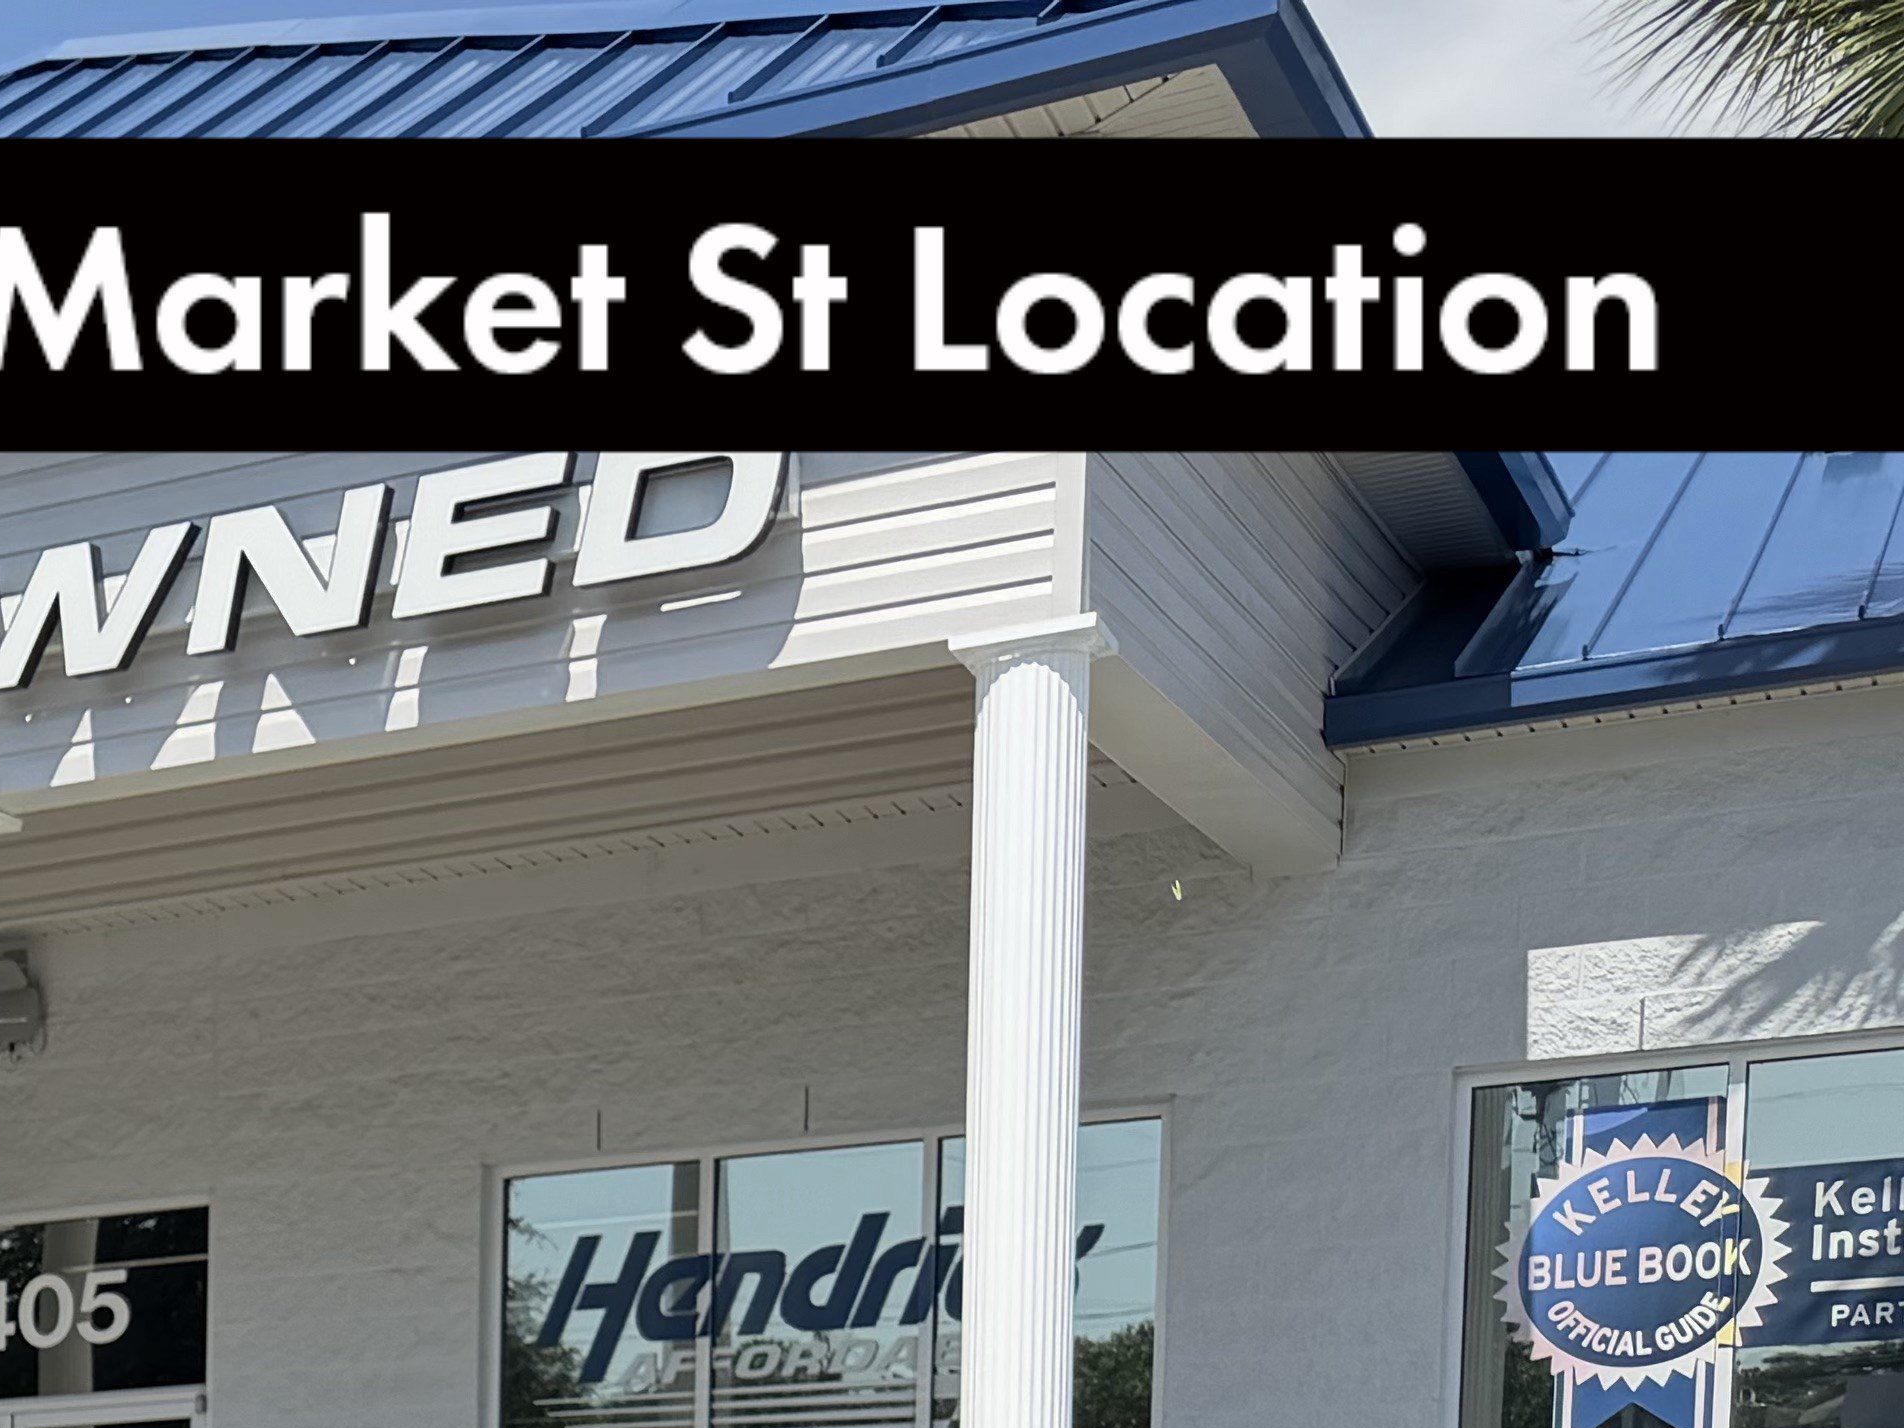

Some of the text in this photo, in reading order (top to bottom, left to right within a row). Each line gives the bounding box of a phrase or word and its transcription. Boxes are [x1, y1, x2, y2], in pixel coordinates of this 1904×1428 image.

[1553, 1169, 1740, 1236] KELLEY
[537, 1206, 1104, 1383] Hendri
[1528, 1238, 1751, 1291] BLUE BOOK
[1548, 1291, 1731, 1356] OFFICIAL GUIDE
